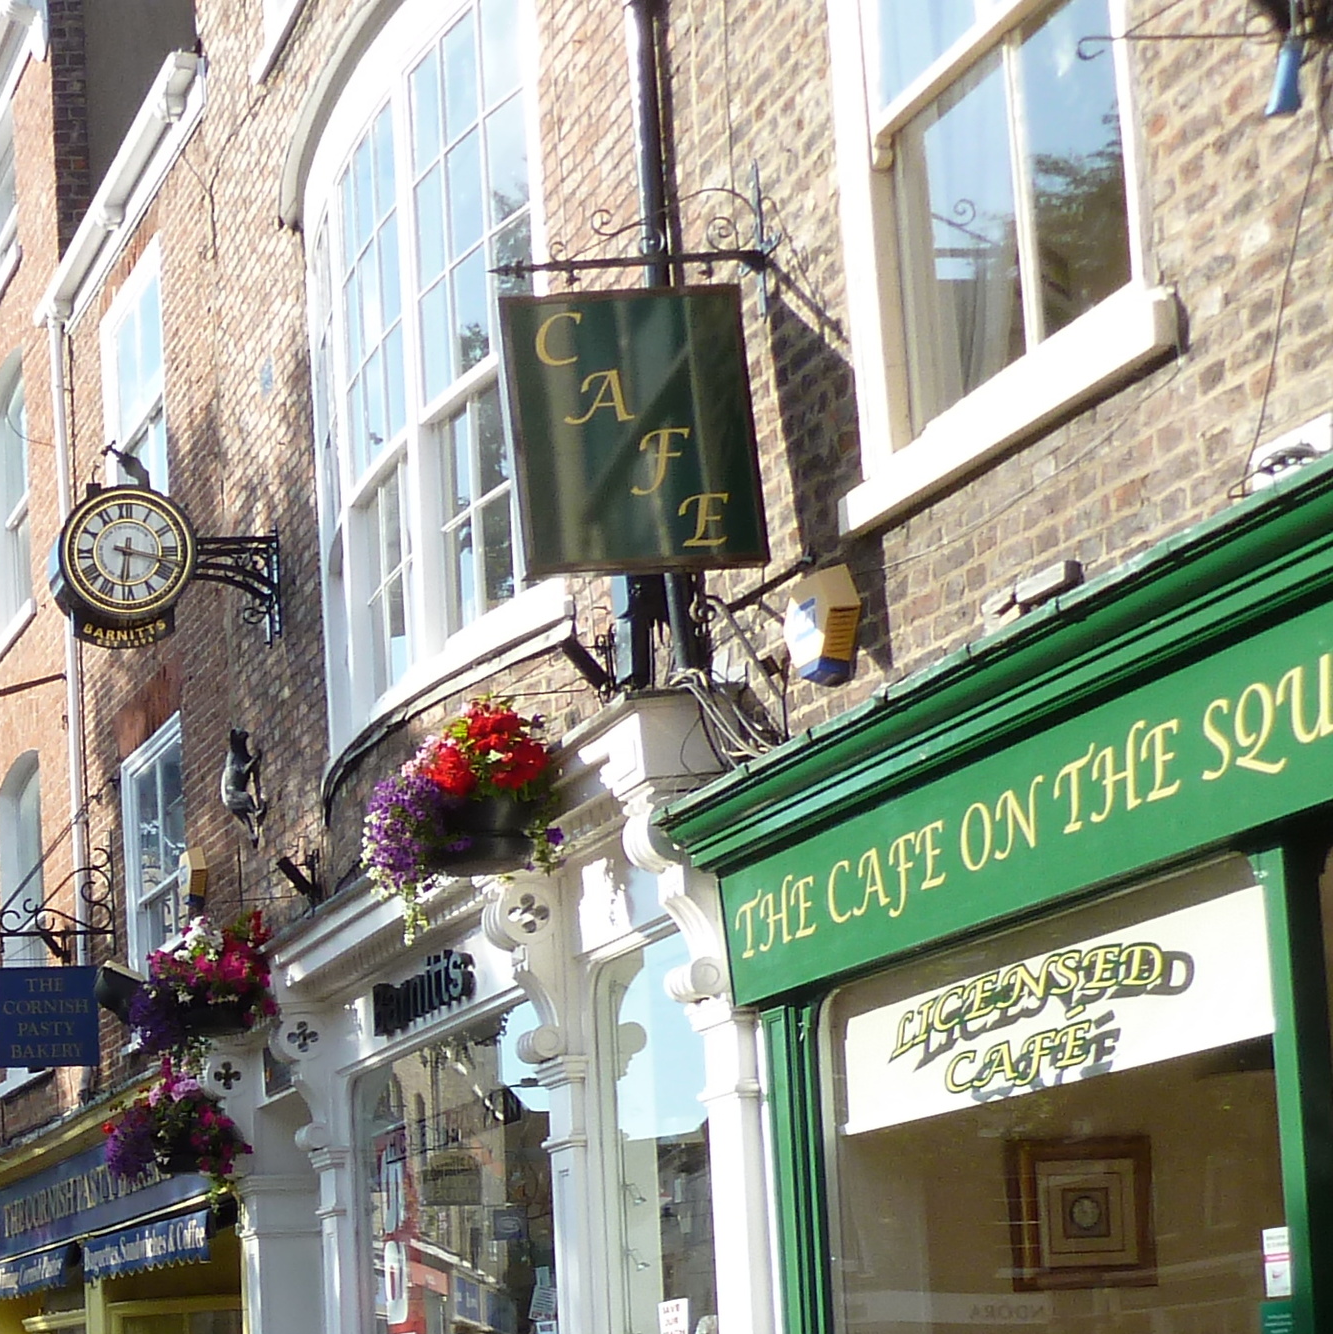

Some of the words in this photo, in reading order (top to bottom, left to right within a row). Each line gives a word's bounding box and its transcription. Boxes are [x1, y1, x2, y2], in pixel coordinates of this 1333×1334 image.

[536, 312, 728, 547] CAFE
[83, 619, 166, 641] BARNITTS
[97, 638, 119, 647] EST
[735, 873, 816, 959] THE
[827, 819, 946, 923] CAFE
[959, 774, 1045, 871] ON
[1053, 718, 1181, 834] THE
[2, 999, 89, 1015] CORNISH
[25, 978, 63, 992] THE
[373, 949, 475, 1037] Barnitts
[888, 942, 1164, 1065] LICENSED
[11, 1043, 83, 1058] BAKERY
[17, 1021, 74, 1036] PASTY
[944, 1004, 1093, 1094] CAFÉ
[4, 1197, 25, 1238] THE
[25, 1176, 77, 1233] CORNISH
[120, 1227, 167, 1262] Sandwiches
[168, 1225, 176, 1253] &
[176, 1218, 205, 1250] Coffee
